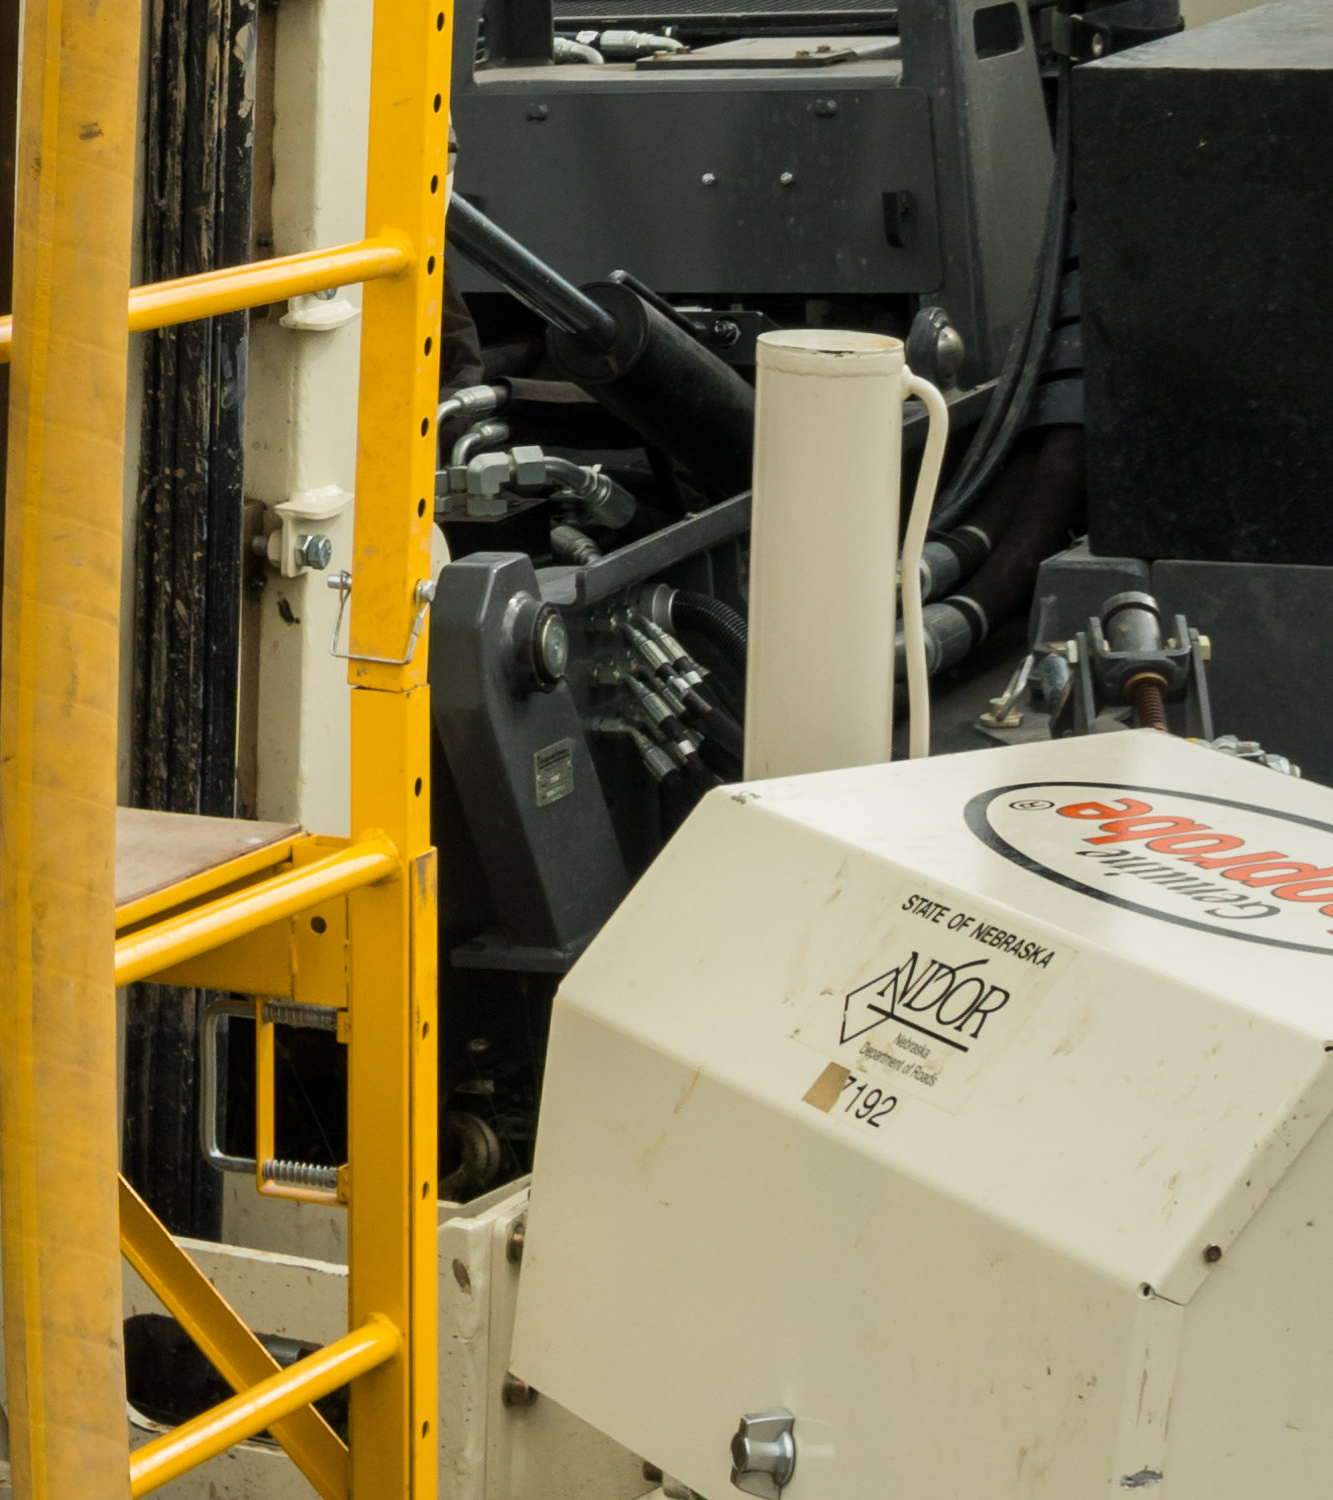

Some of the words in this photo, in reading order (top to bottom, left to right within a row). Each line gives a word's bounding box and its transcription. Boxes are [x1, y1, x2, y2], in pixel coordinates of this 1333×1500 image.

[1075, 848, 1282, 920] Genuine
[902, 894, 950, 924] STATE
[947, 913, 975, 933] OF
[970, 922, 1055, 969] NEBRASKA
[876, 951, 1011, 1040] NDOR
[893, 1033, 932, 1060] Nebraska
[910, 1065, 938, 1087] Roads
